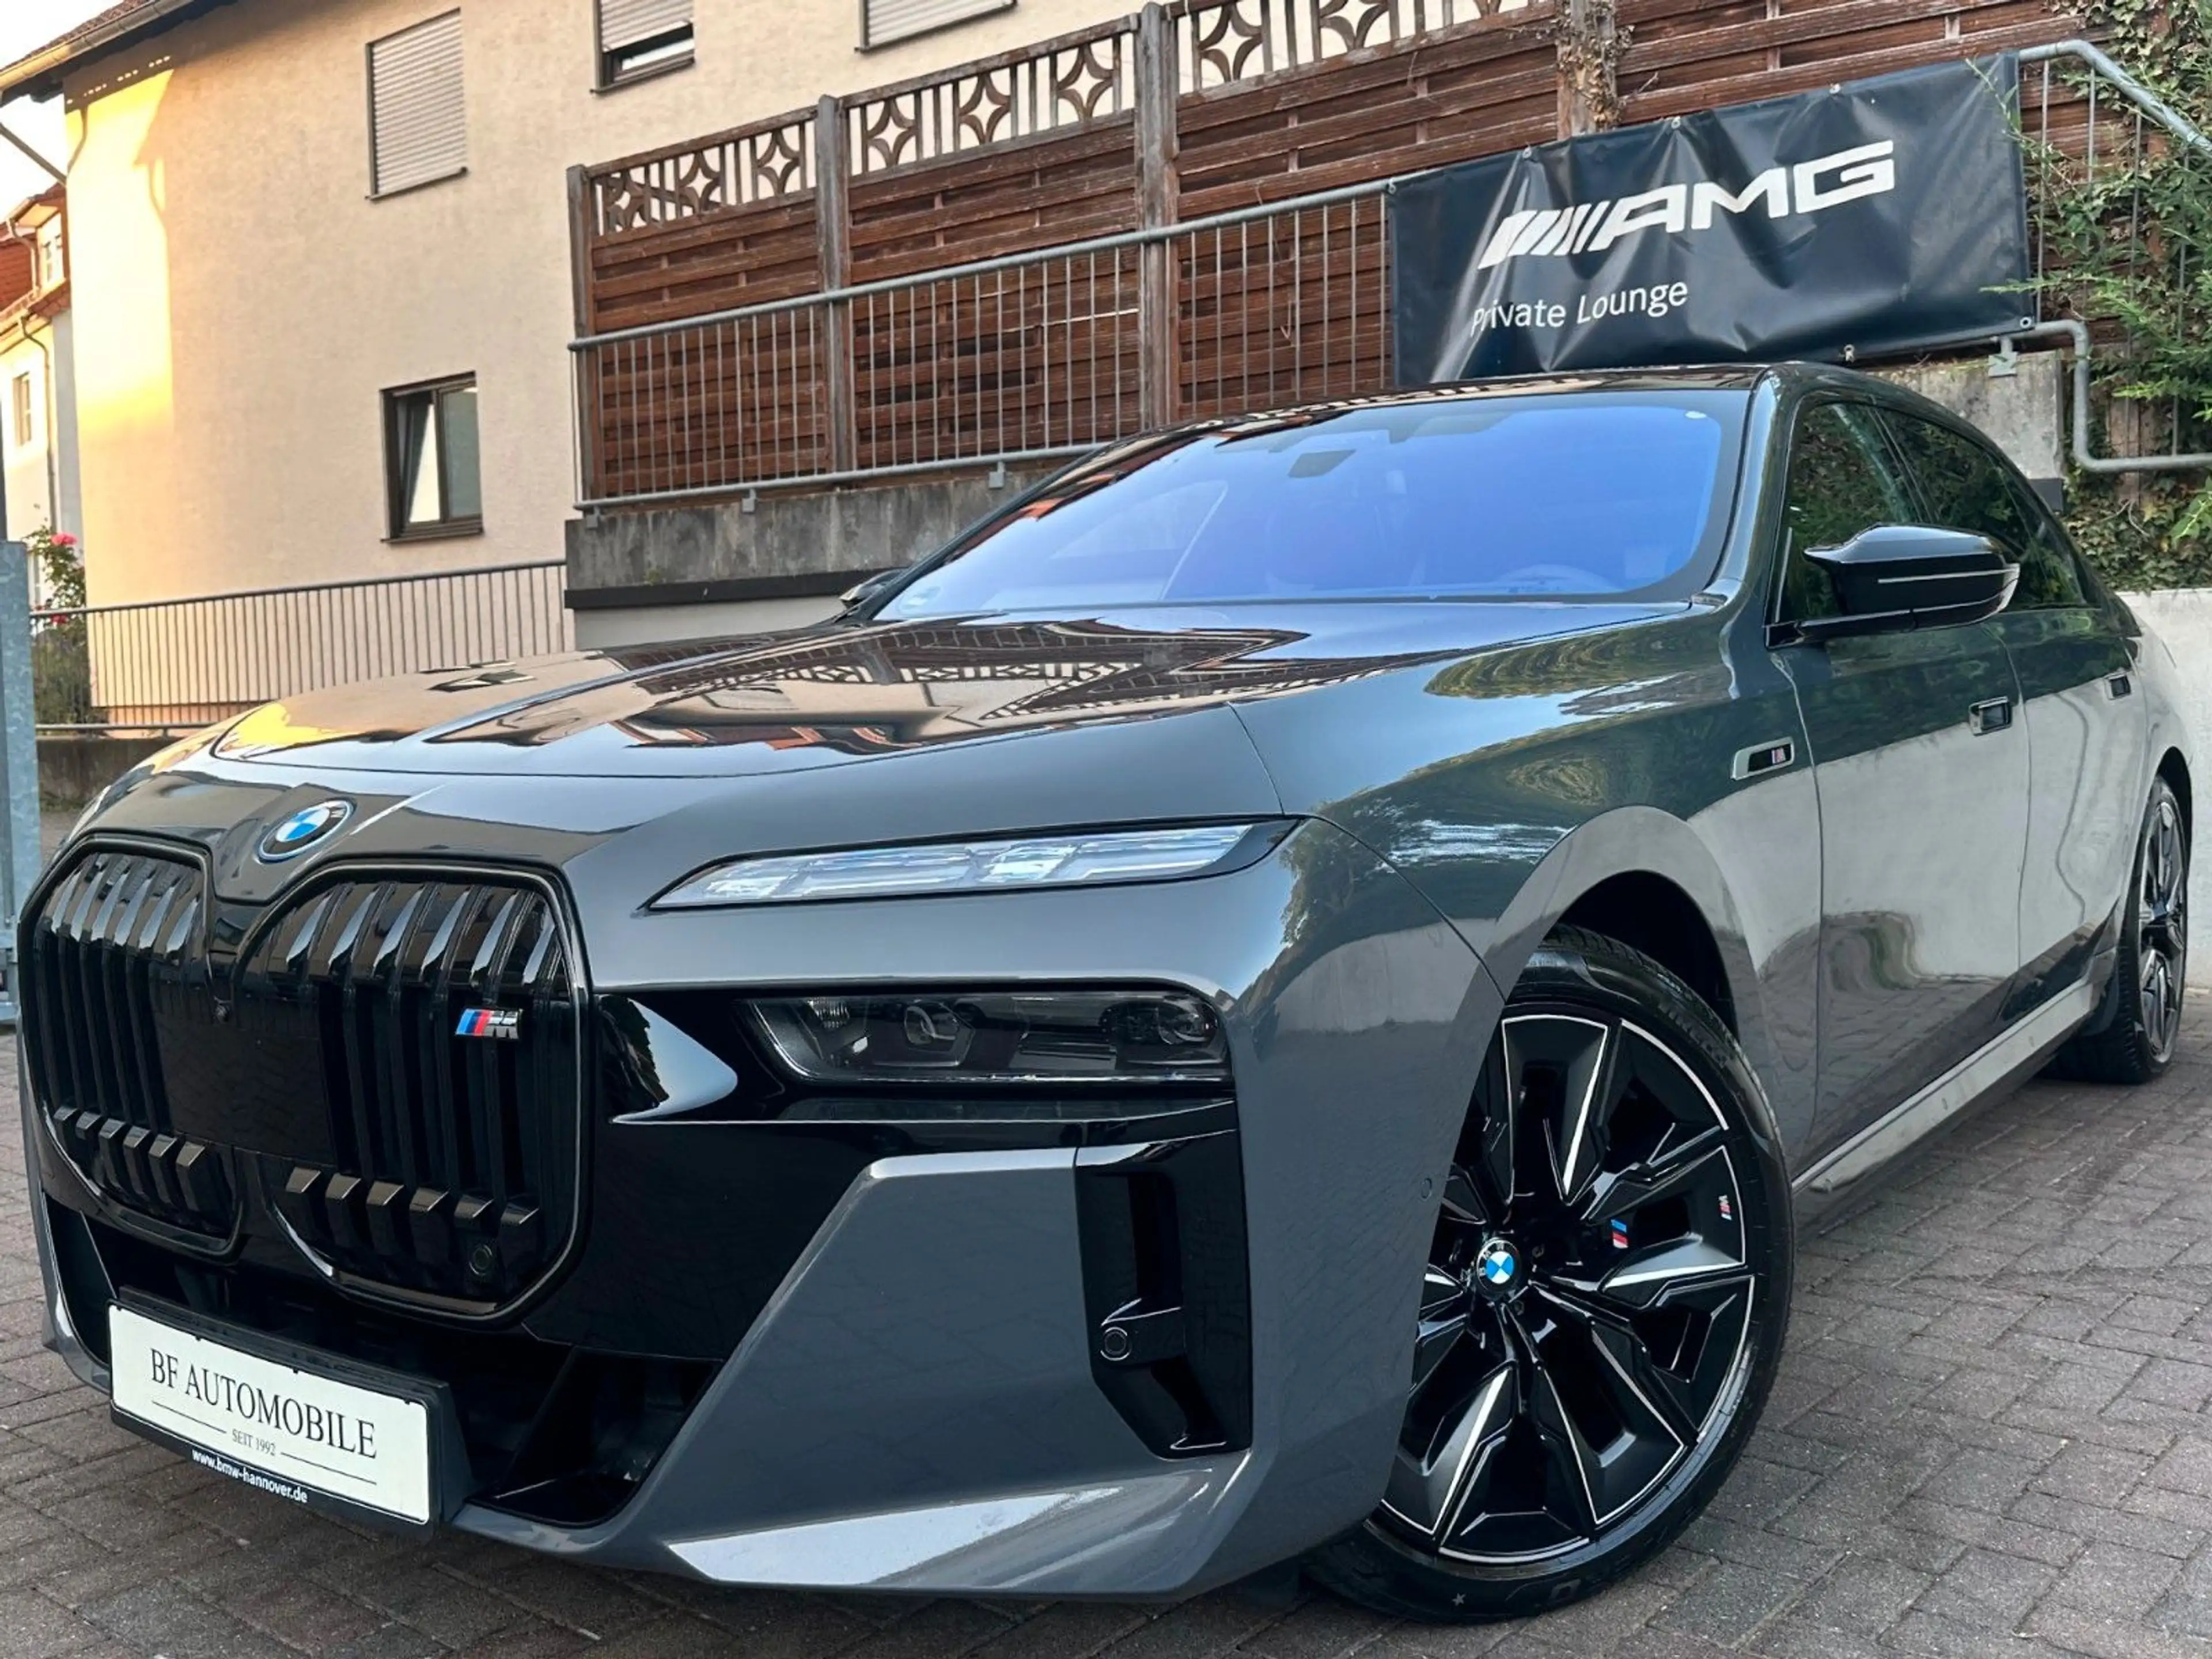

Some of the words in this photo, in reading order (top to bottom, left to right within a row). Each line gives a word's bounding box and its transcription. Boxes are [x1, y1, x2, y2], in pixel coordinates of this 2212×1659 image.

[1589, 140, 1895, 251] AMG
[1470, 299, 1567, 338] Private
[1577, 280, 1688, 325] Lounge
[150, 1347, 179, 1389] BF
[184, 1363, 378, 1460] AUTOMOBILE
[232, 1428, 253, 1448] SEIT
[255, 1437, 276, 1457] 1992
[191, 1448, 308, 1504] www.bmw-hannover.de
